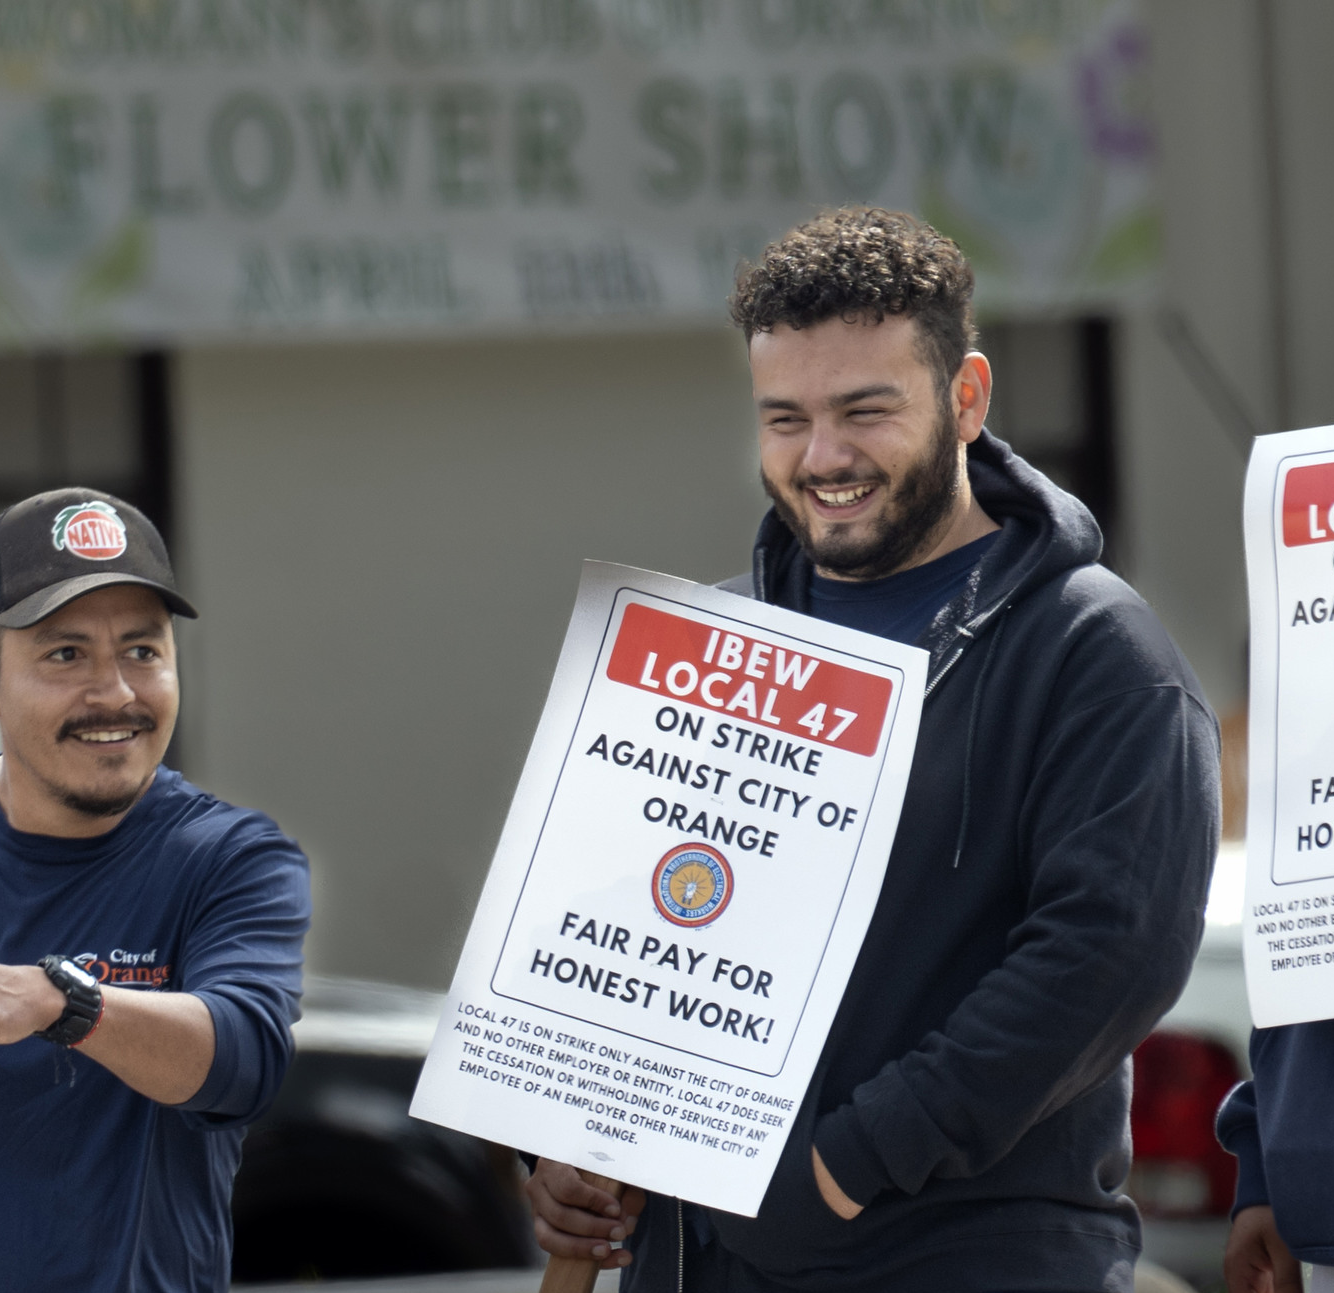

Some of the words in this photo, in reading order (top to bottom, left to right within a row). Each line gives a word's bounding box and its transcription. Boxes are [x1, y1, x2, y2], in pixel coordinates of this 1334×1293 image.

[41, 78, 587, 216] FLOWER
[641, 62, 1027, 203] SHOW
[67, 519, 124, 547] NATIVE
[639, 651, 780, 724] LOCAL
[797, 702, 857, 741] 47
[703, 630, 819, 690] IBEW
[655, 705, 704, 740] ON
[710, 722, 822, 776] STRIKE
[585, 733, 731, 794] AGAINST
[738, 778, 811, 817] CITY
[817, 801, 857, 831] OF
[643, 796, 779, 857] ORANGE
[110, 948, 140, 966] City
[141, 949, 157, 964] of
[559, 911, 630, 954] FAIR
[639, 935, 707, 975] PAY
[711, 957, 772, 998] FOR
[1267, 939, 1285, 951] THE
[529, 948, 660, 1008] HONEST
[669, 989, 774, 1044] WORK!
[457, 1001, 496, 1023] LOCAL
[499, 1015, 517, 1027] 47
[518, 1020, 530, 1033] IS
[533, 1025, 553, 1040] ON
[554, 1032, 596, 1053] STRIKE
[598, 1045, 631, 1063] ONLY
[632, 1056, 686, 1080] AGAINST
[687, 1071, 708, 1087] THE
[709, 1079, 733, 1094] CITY
[734, 1086, 750, 1098] OF
[751, 1090, 794, 1111] ORANGE
